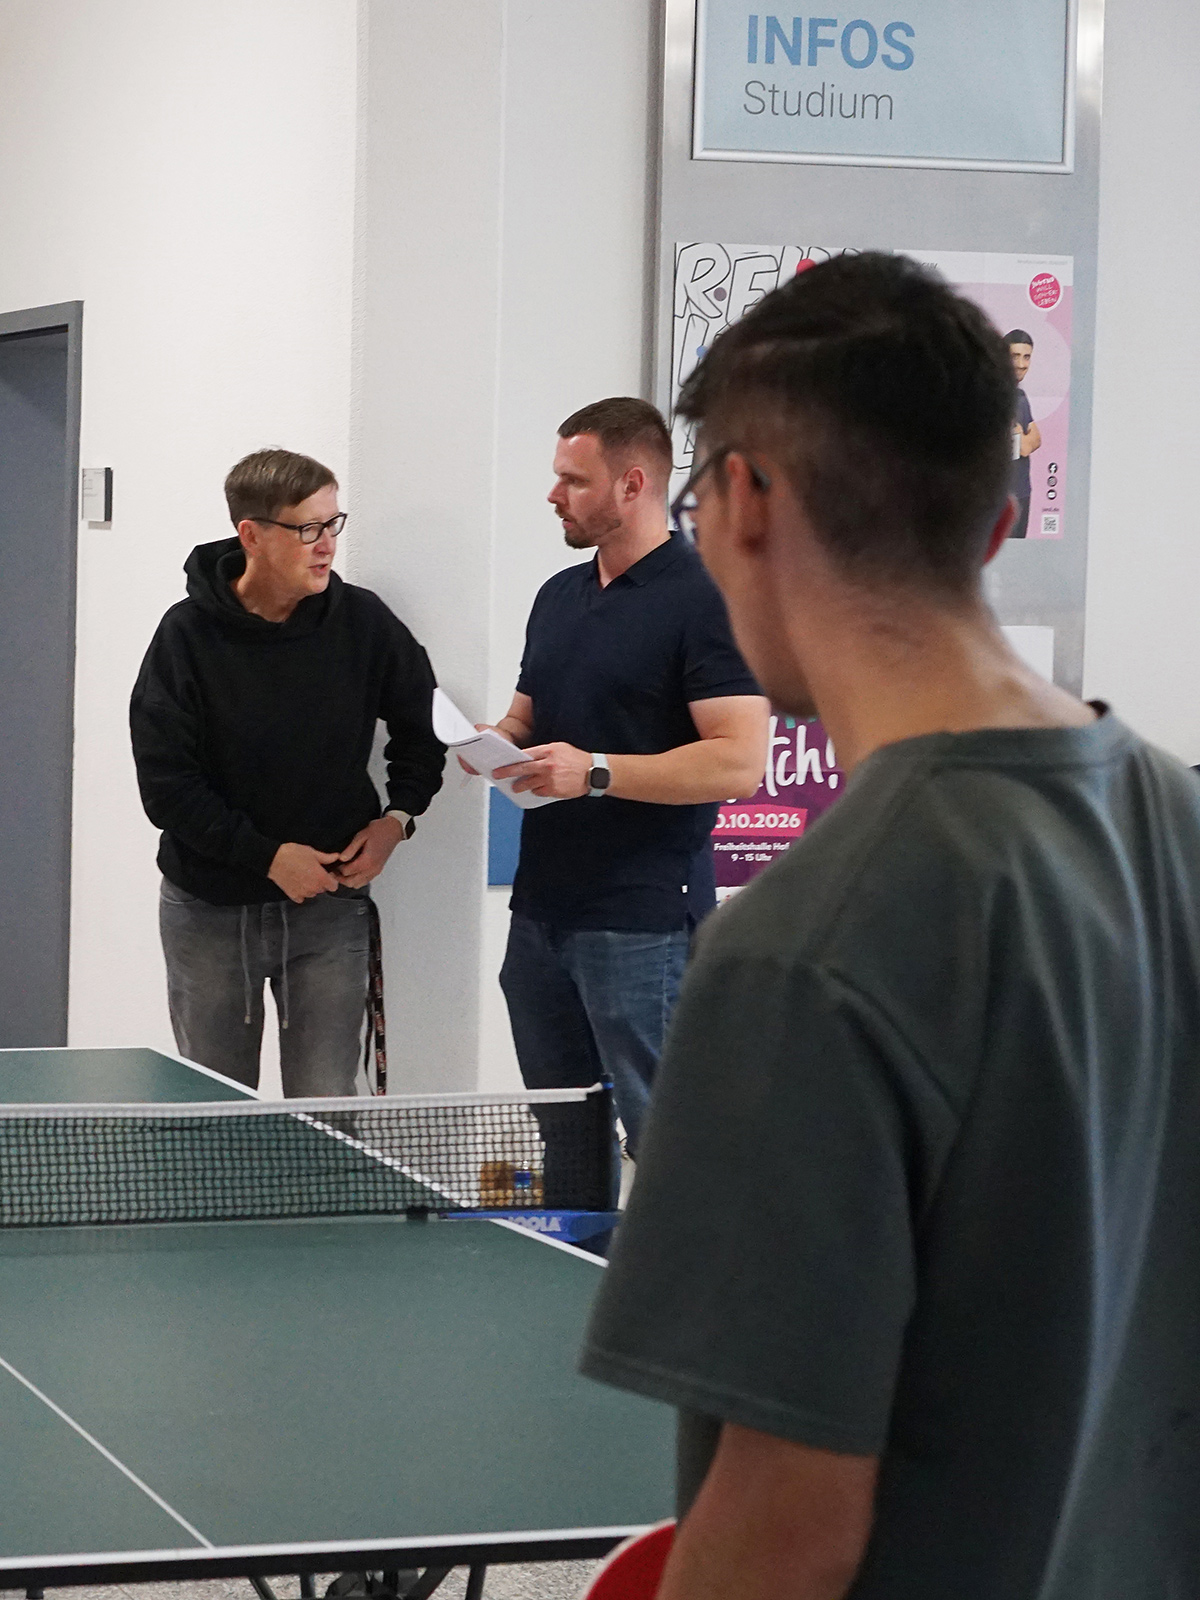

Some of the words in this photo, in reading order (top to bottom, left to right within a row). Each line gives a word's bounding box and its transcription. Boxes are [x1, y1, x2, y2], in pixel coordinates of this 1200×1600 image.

[747, 15, 916, 71] INFOS
[743, 80, 894, 120] Studium
[759, 715, 838, 797] tch!
[715, 813, 801, 828] 0.10.2026
[772, 842, 790, 851] Hof
[755, 853, 773, 861] Uhr
[508, 1216, 562, 1231] OOLA
